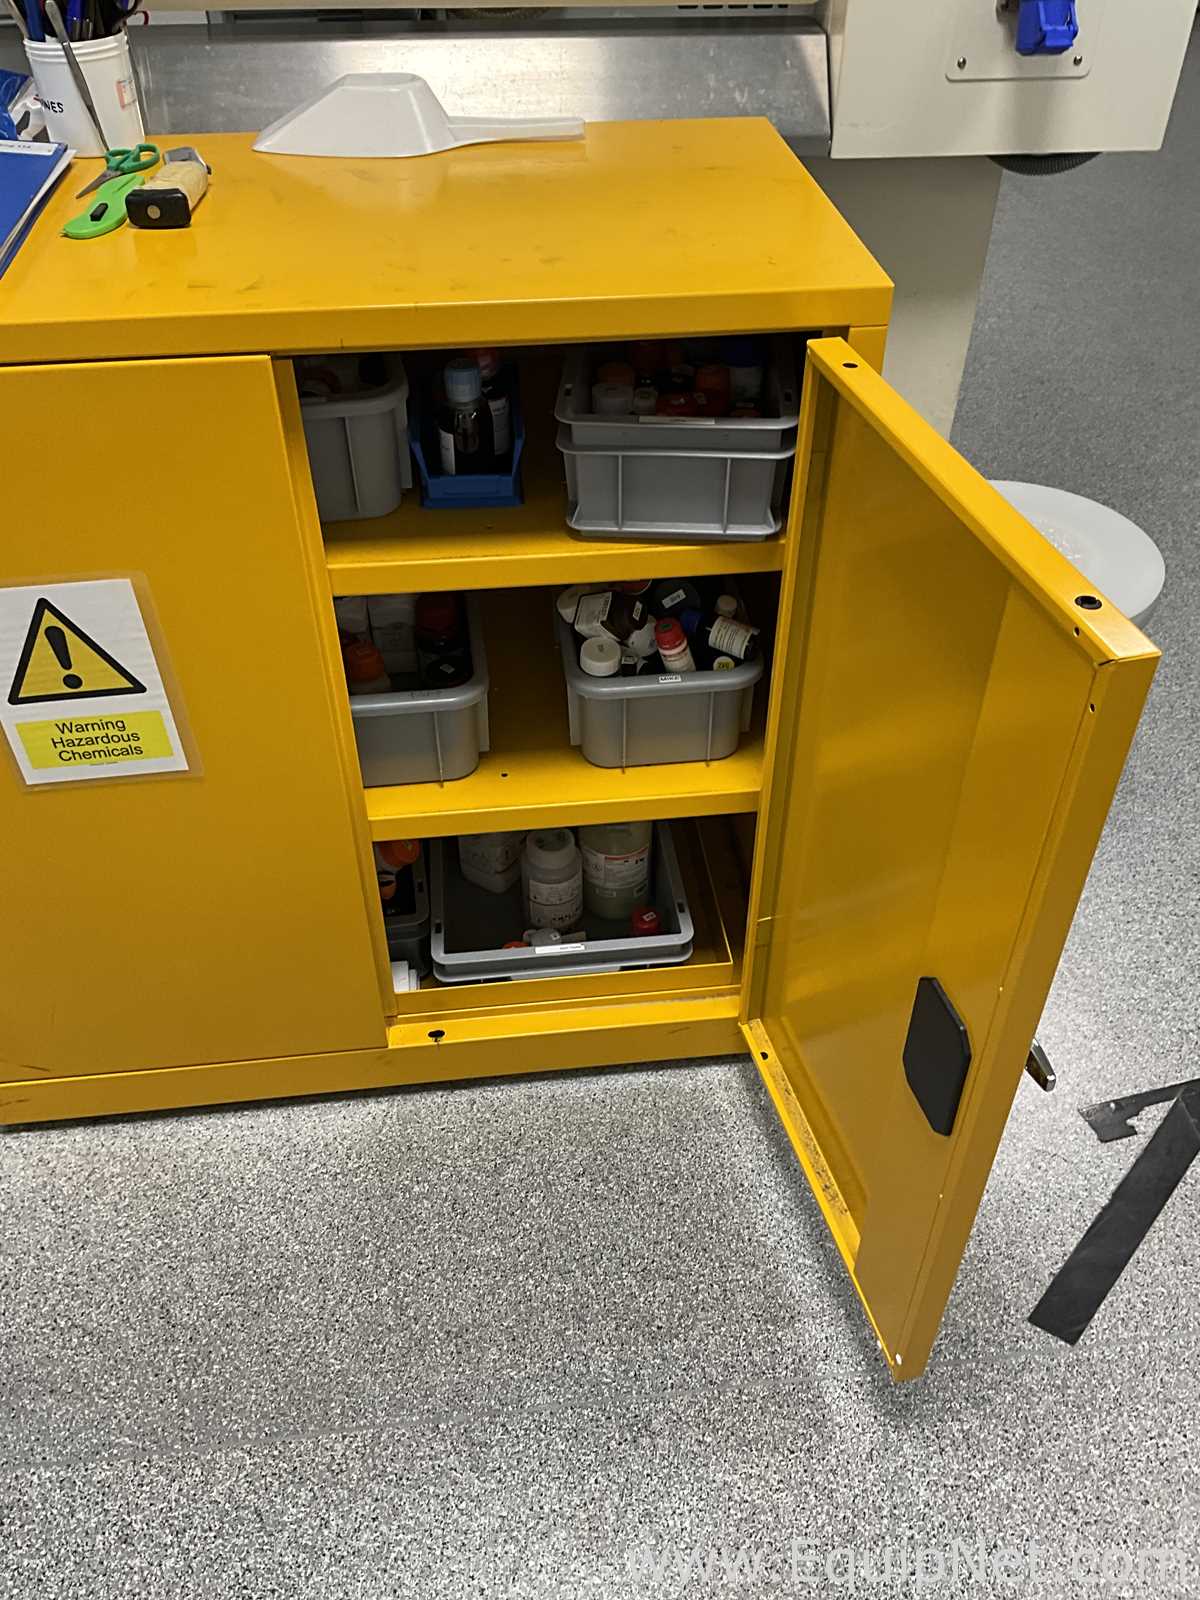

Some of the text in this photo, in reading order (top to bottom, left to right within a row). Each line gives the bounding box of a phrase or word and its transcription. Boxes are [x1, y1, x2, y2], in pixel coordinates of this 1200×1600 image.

[55, 719, 127, 734] Warning
[51, 732, 141, 749] Hazardous
[59, 744, 144, 762] Chemicals
